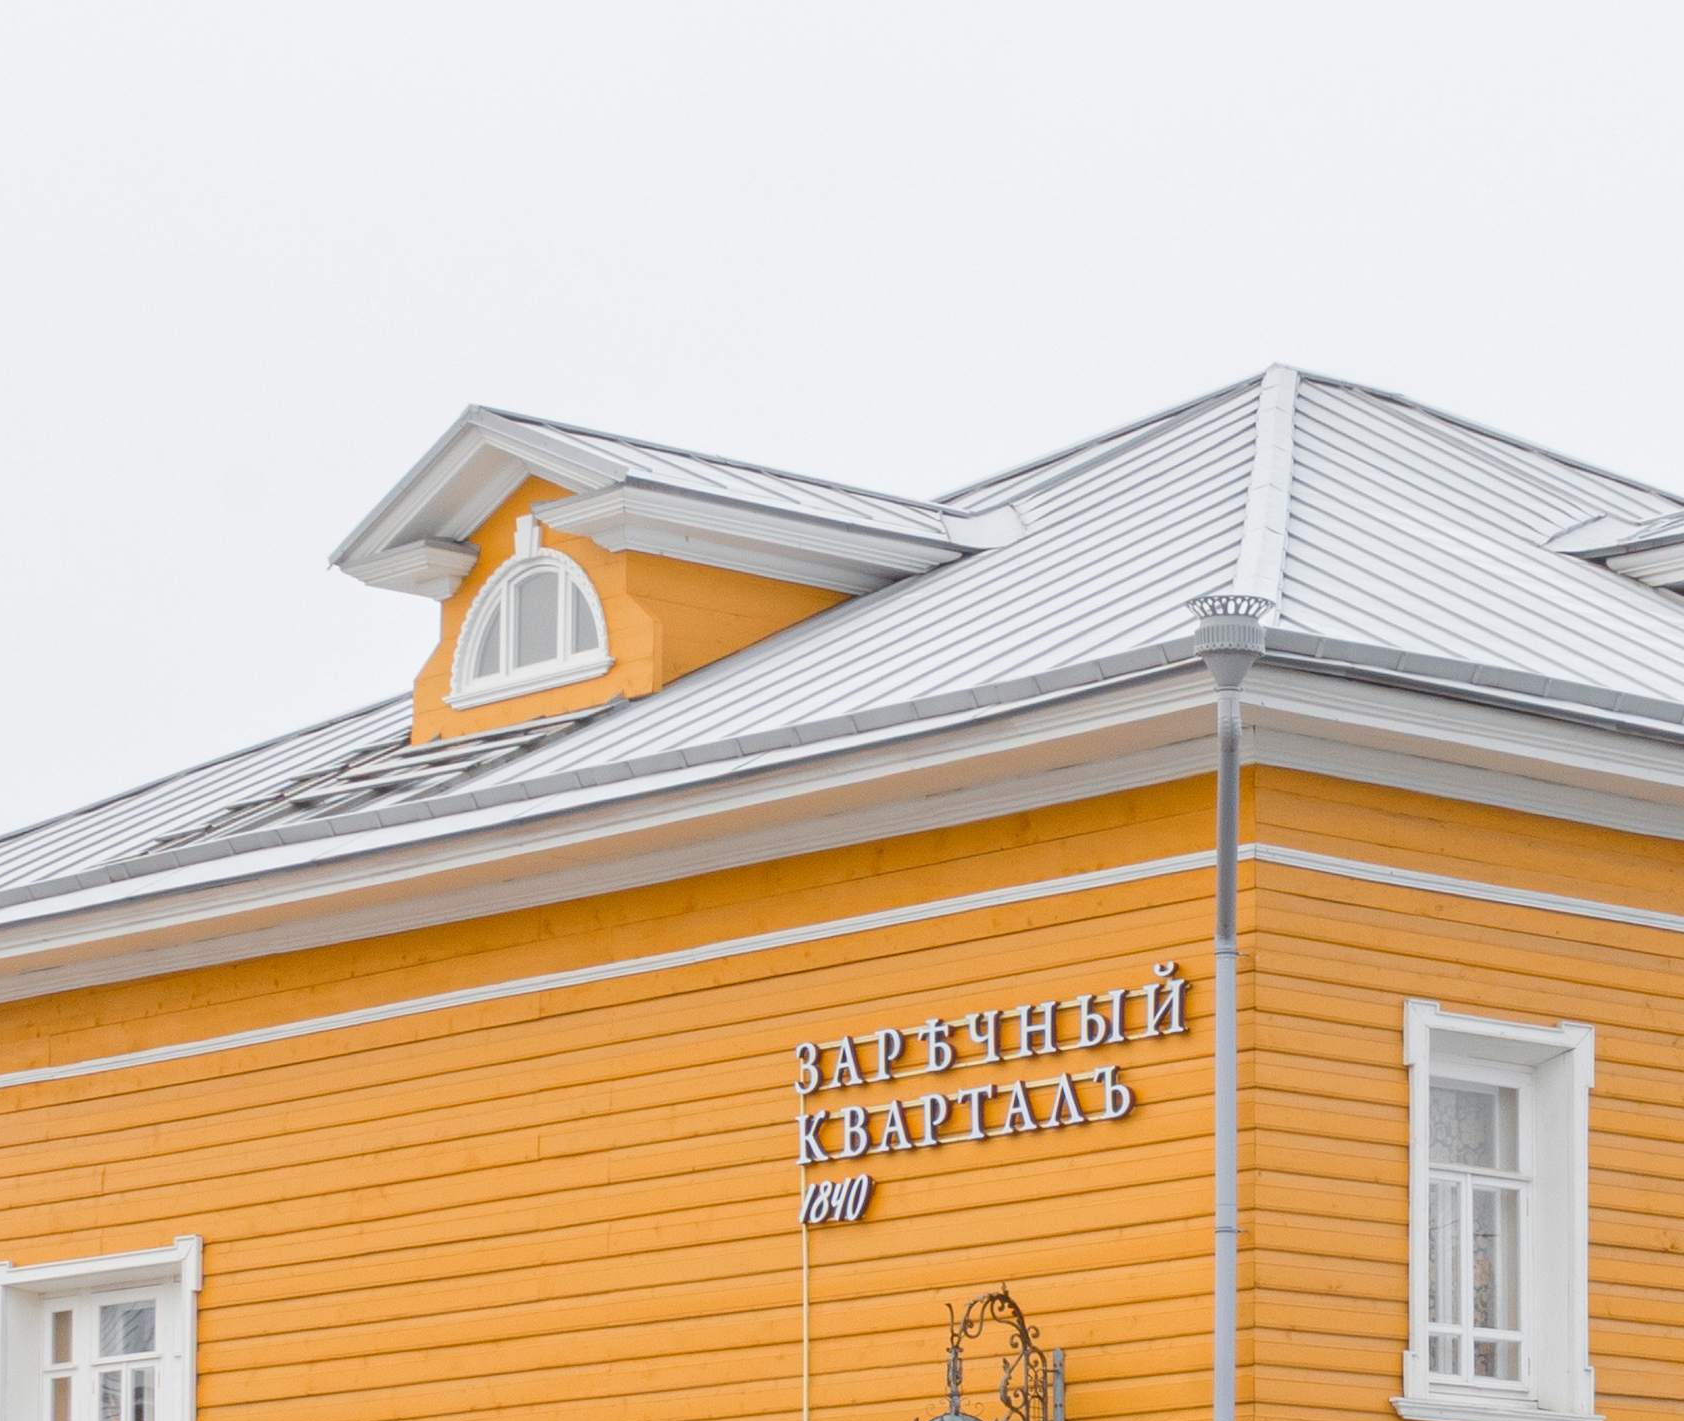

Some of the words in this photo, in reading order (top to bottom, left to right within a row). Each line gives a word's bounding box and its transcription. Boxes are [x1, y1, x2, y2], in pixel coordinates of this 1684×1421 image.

[794, 961, 1190, 1095] ЗАРѢЧНЫЙ
[795, 1065, 1135, 1166] КВАРТАЛЪ
[798, 1173, 875, 1224] 1840
